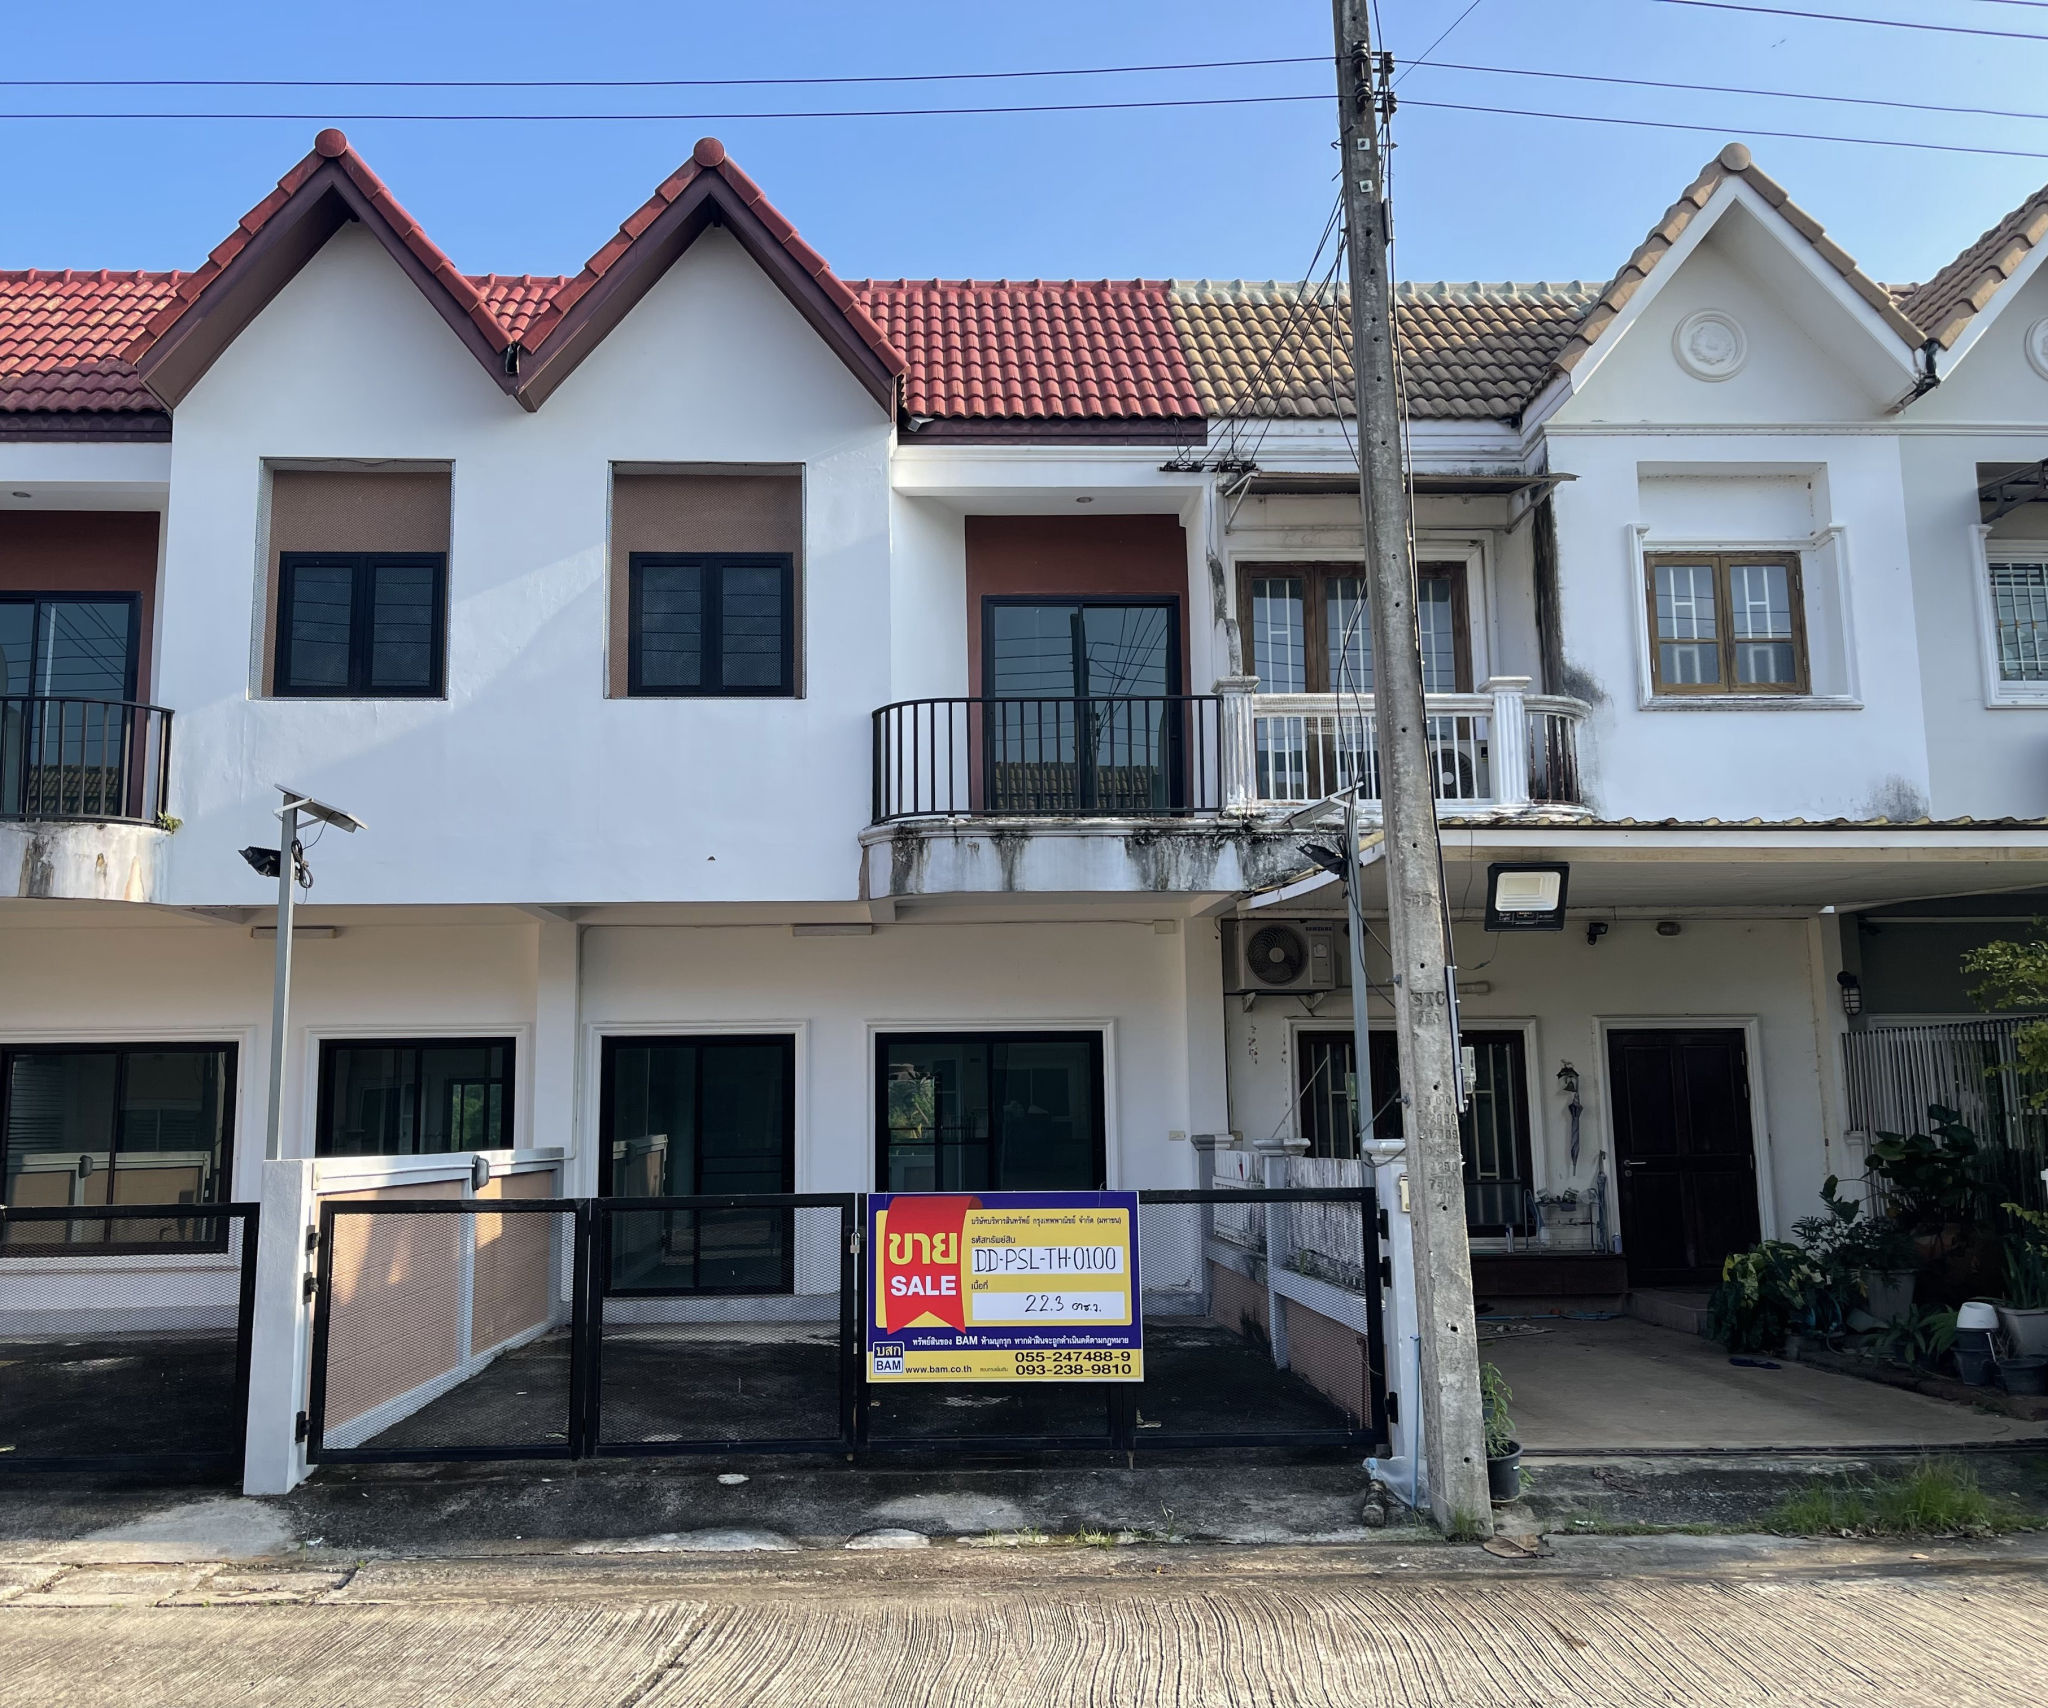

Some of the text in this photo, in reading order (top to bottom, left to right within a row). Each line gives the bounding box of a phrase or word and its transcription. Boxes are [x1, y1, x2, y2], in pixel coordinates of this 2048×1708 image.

[1079, 1215, 1094, 1224] จำกัด
[1097, 1216, 1122, 1225] (มหาชน)
[971, 1234, 1016, 1244] รหัสทรัพย์สิน
[889, 1232, 958, 1265] ขาย
[974, 1246, 1116, 1272] DD-PSL-TH-0100
[890, 1276, 957, 1296] SALE
[971, 1279, 989, 1290] เนื้อที่
[1025, 1294, 1065, 1313] 22.3
[912, 1336, 953, 1346] ทรัพย์สินของ
[956, 1335, 978, 1346] BAM
[981, 1336, 1012, 1348] ห้ามบุกรุก
[876, 1346, 901, 1357] บสก
[1015, 1351, 1131, 1362] 055-247488-9
[876, 1360, 901, 1371] BAM
[905, 1365, 972, 1374] www.bam.co.th
[1015, 1364, 1132, 1375] 093-238-9810
